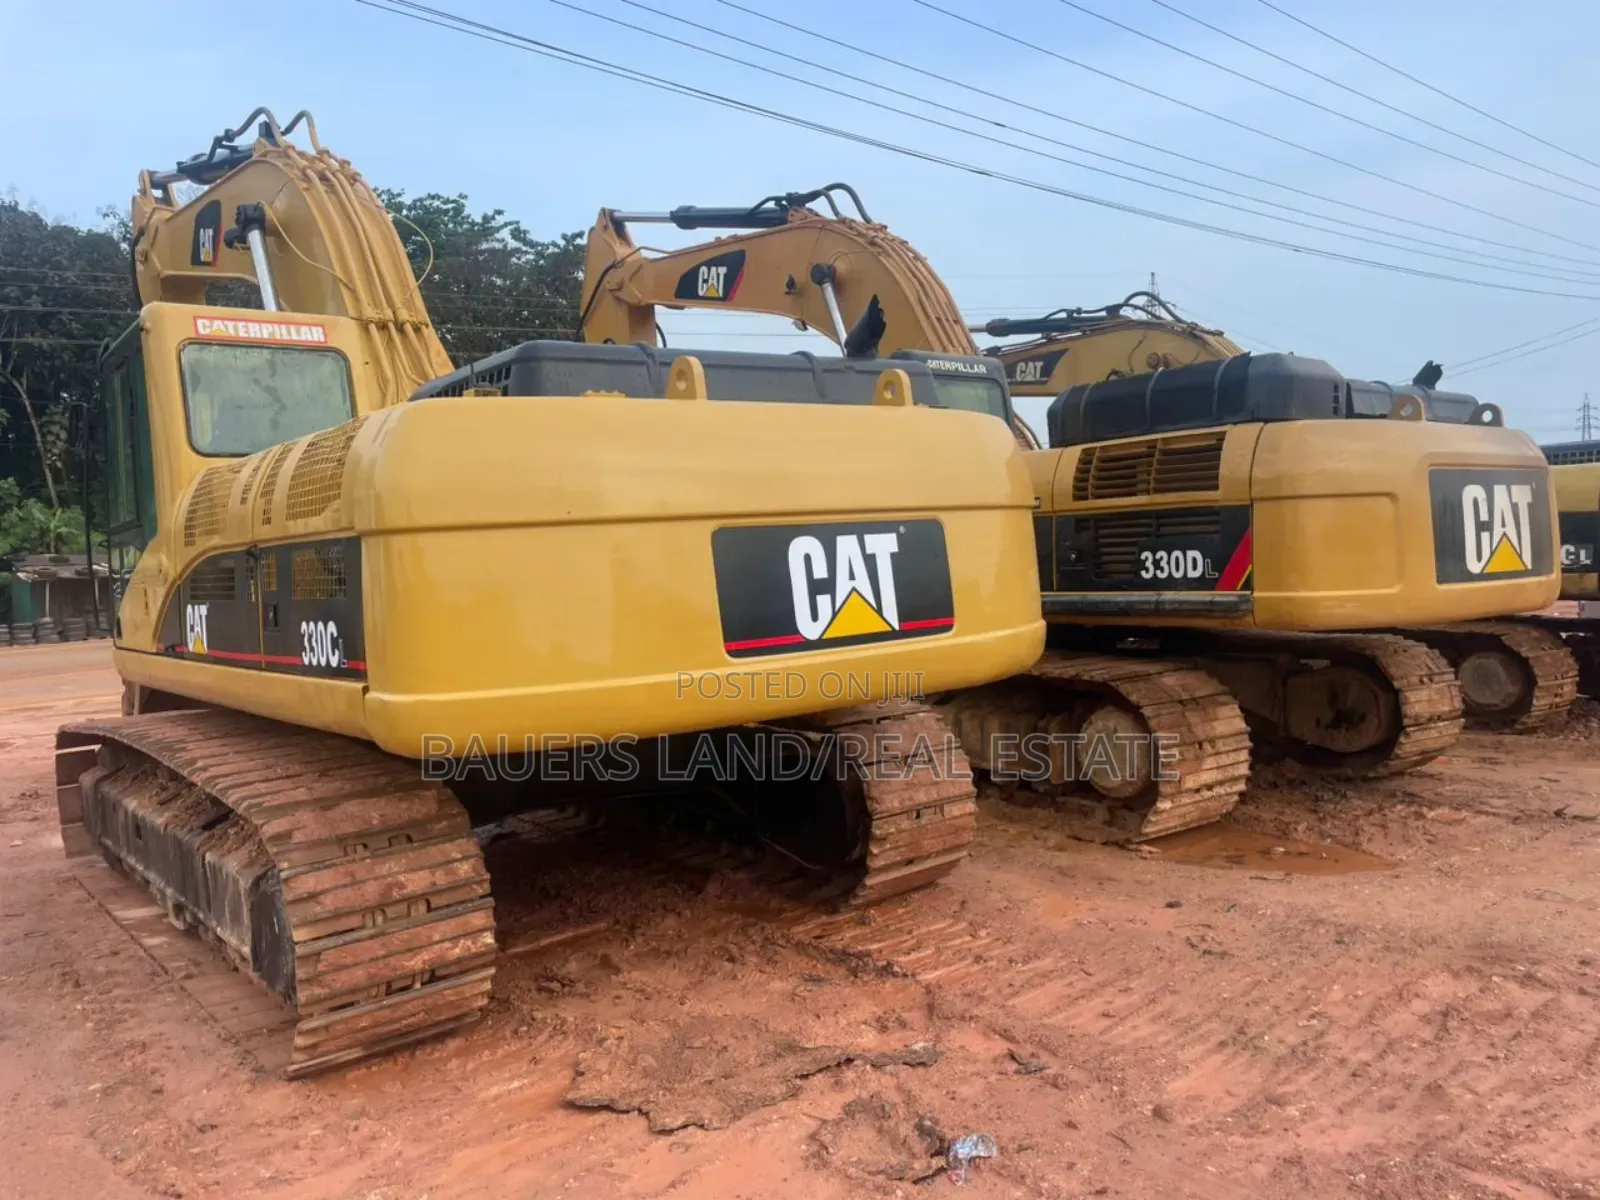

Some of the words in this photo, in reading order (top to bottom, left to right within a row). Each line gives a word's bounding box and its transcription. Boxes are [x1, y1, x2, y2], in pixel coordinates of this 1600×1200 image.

[199, 228, 214, 262] CAT
[697, 265, 728, 297] CAT
[196, 319, 327, 342] CATERPILLAR
[926, 359, 987, 374] CATERPILLAR
[1015, 361, 1044, 380] CAT
[1462, 484, 1532, 574] CAT
[788, 532, 900, 641] CAT
[186, 603, 208, 655] CAT
